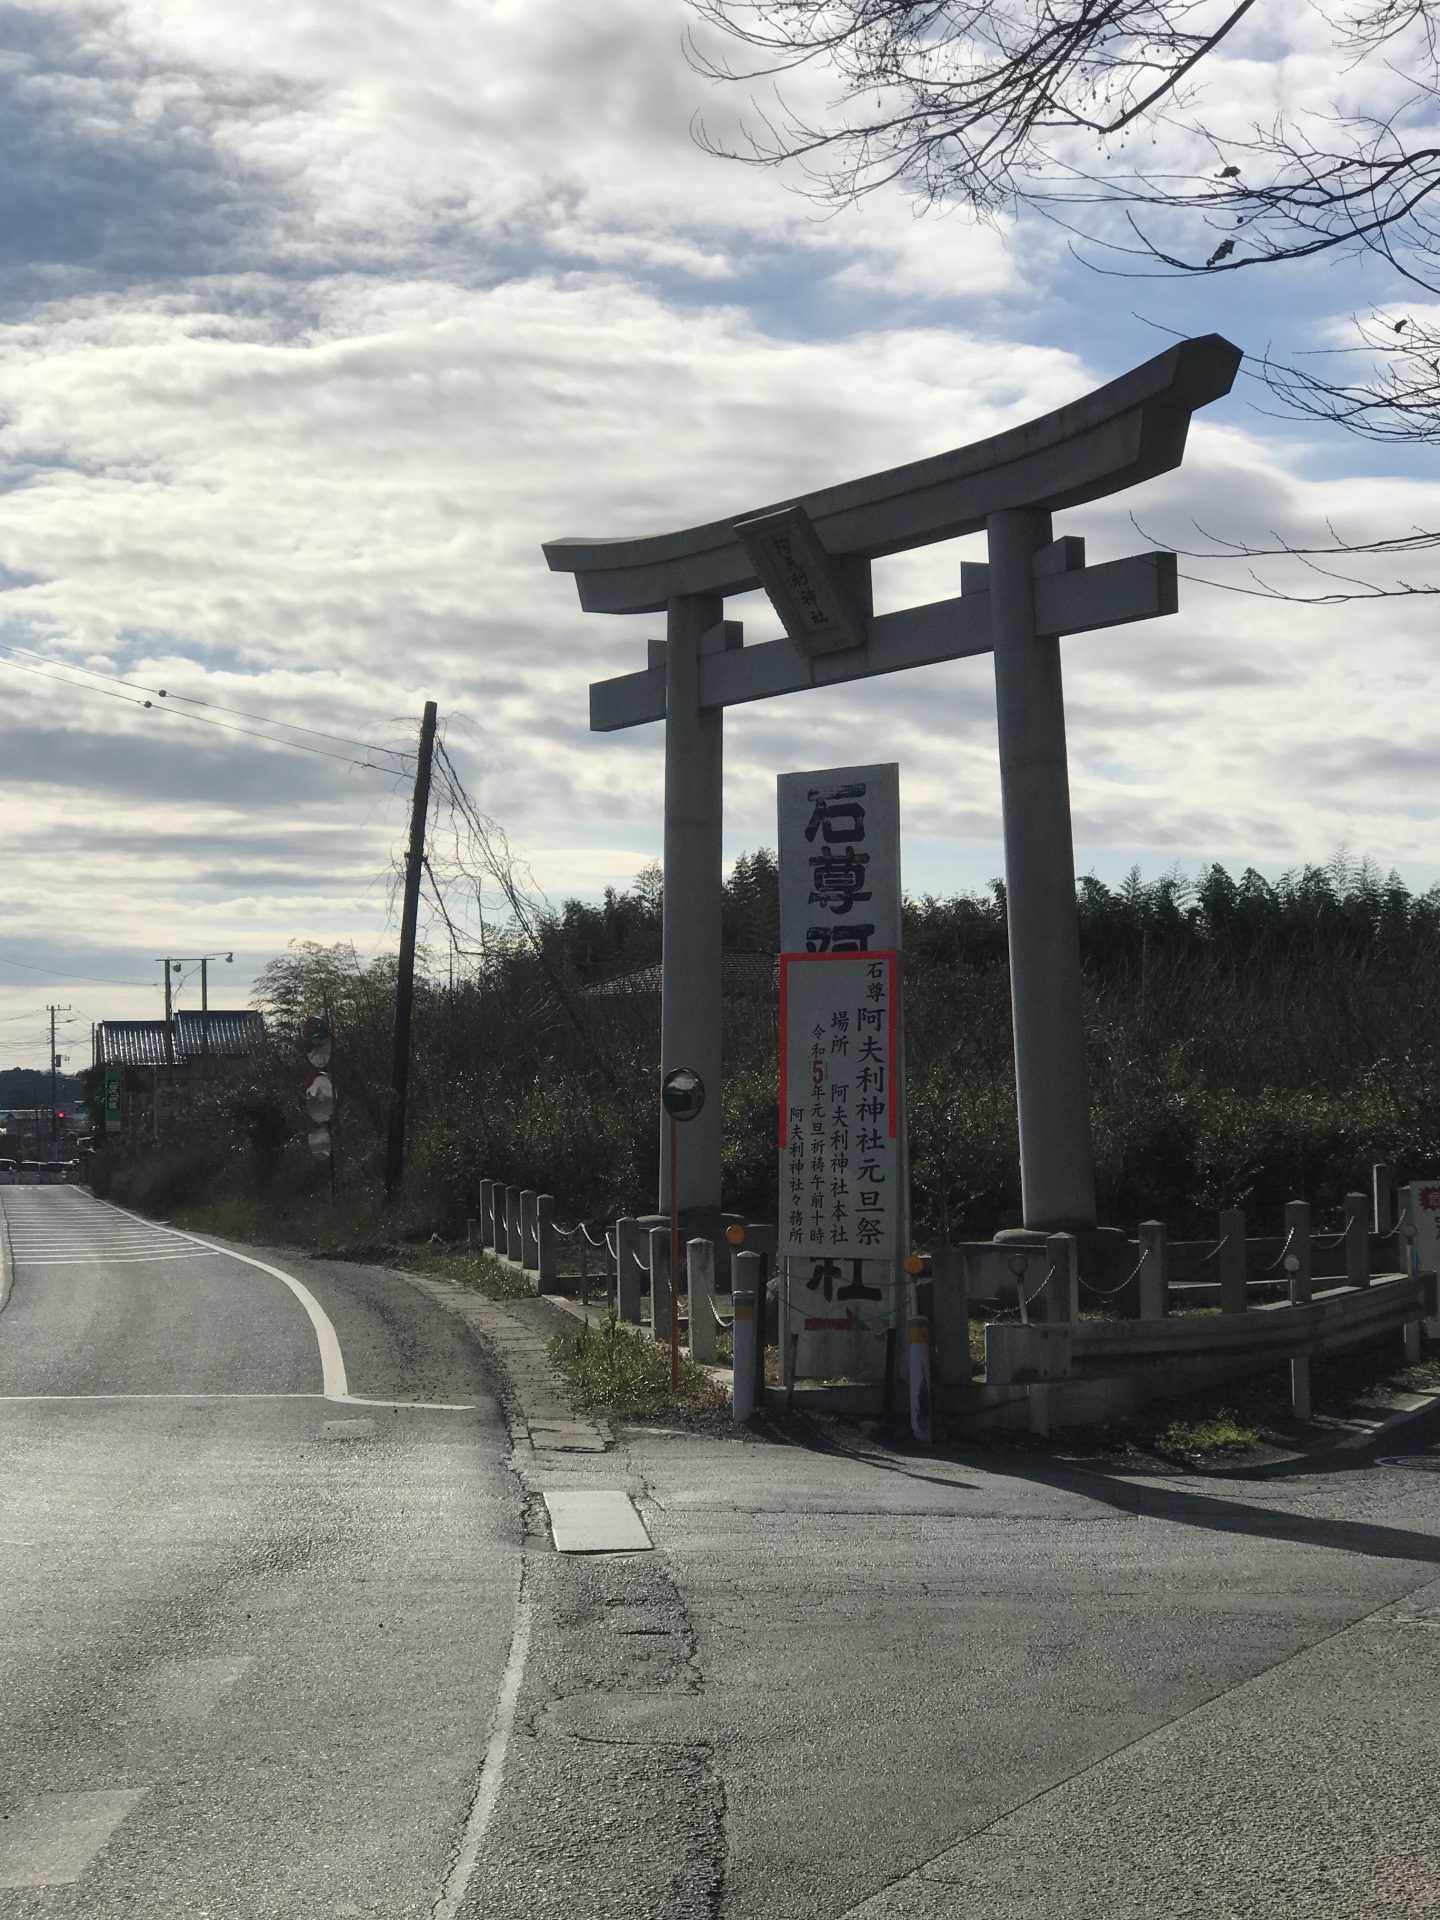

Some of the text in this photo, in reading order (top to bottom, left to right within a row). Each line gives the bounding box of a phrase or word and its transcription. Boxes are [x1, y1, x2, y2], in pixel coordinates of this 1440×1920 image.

[788, 1107, 805, 1244] 阿夫利神社々務所
[829, 1011, 850, 1245] 場所 阿夫利神社本社
